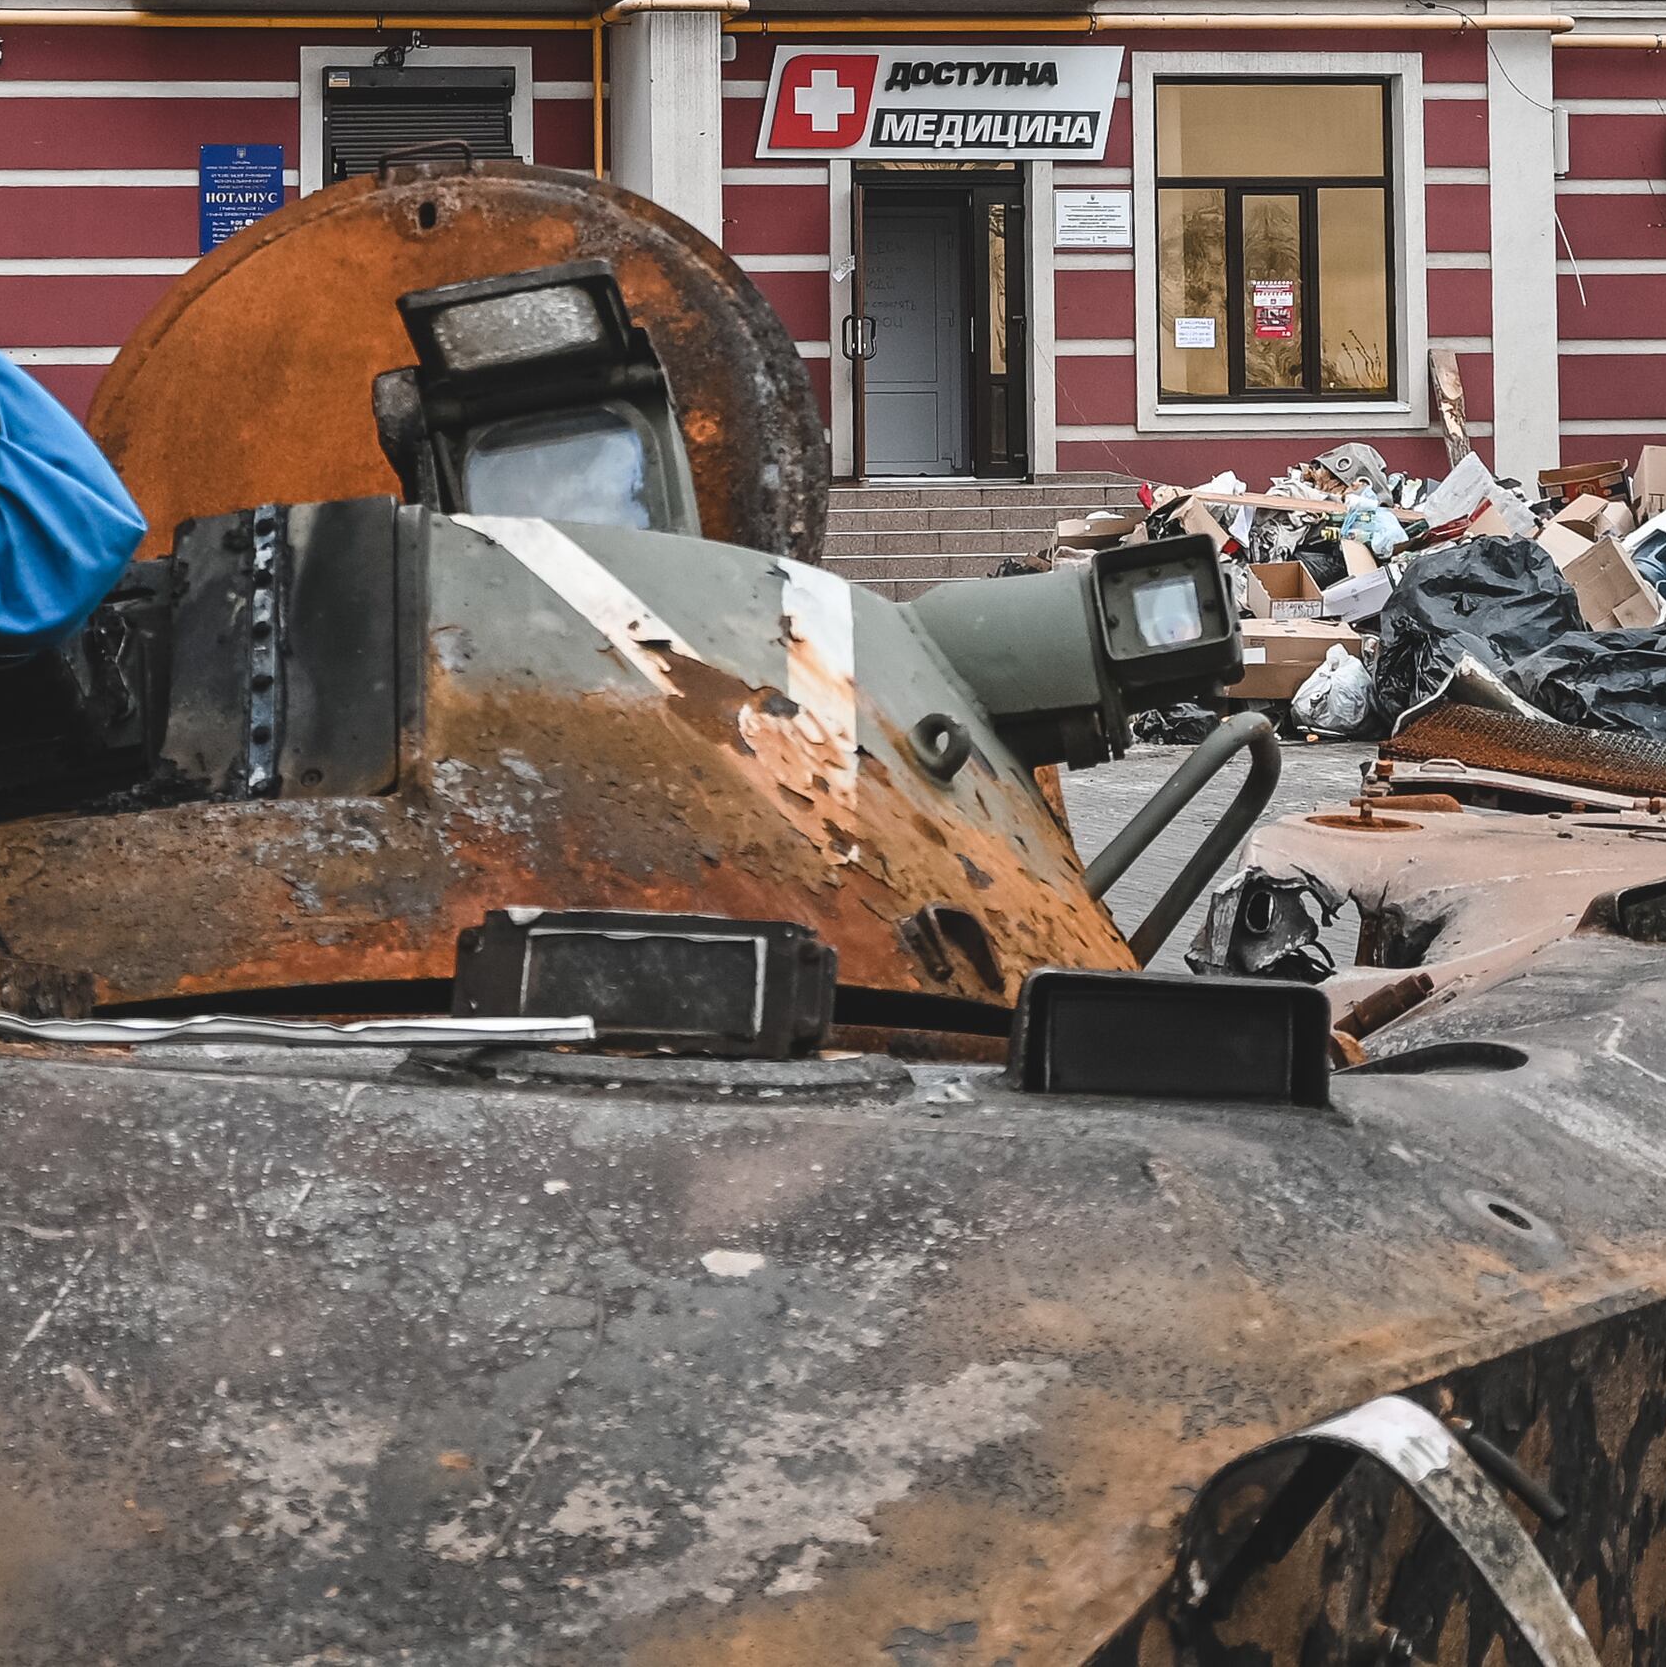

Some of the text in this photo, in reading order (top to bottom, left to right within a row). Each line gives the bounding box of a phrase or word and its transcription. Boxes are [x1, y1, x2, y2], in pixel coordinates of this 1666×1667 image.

[884, 61, 1059, 91] ДОСТУПНА
[879, 113, 1093, 149] МЕДИЦИНА
[205, 192, 278, 204] НОТАРІУС
